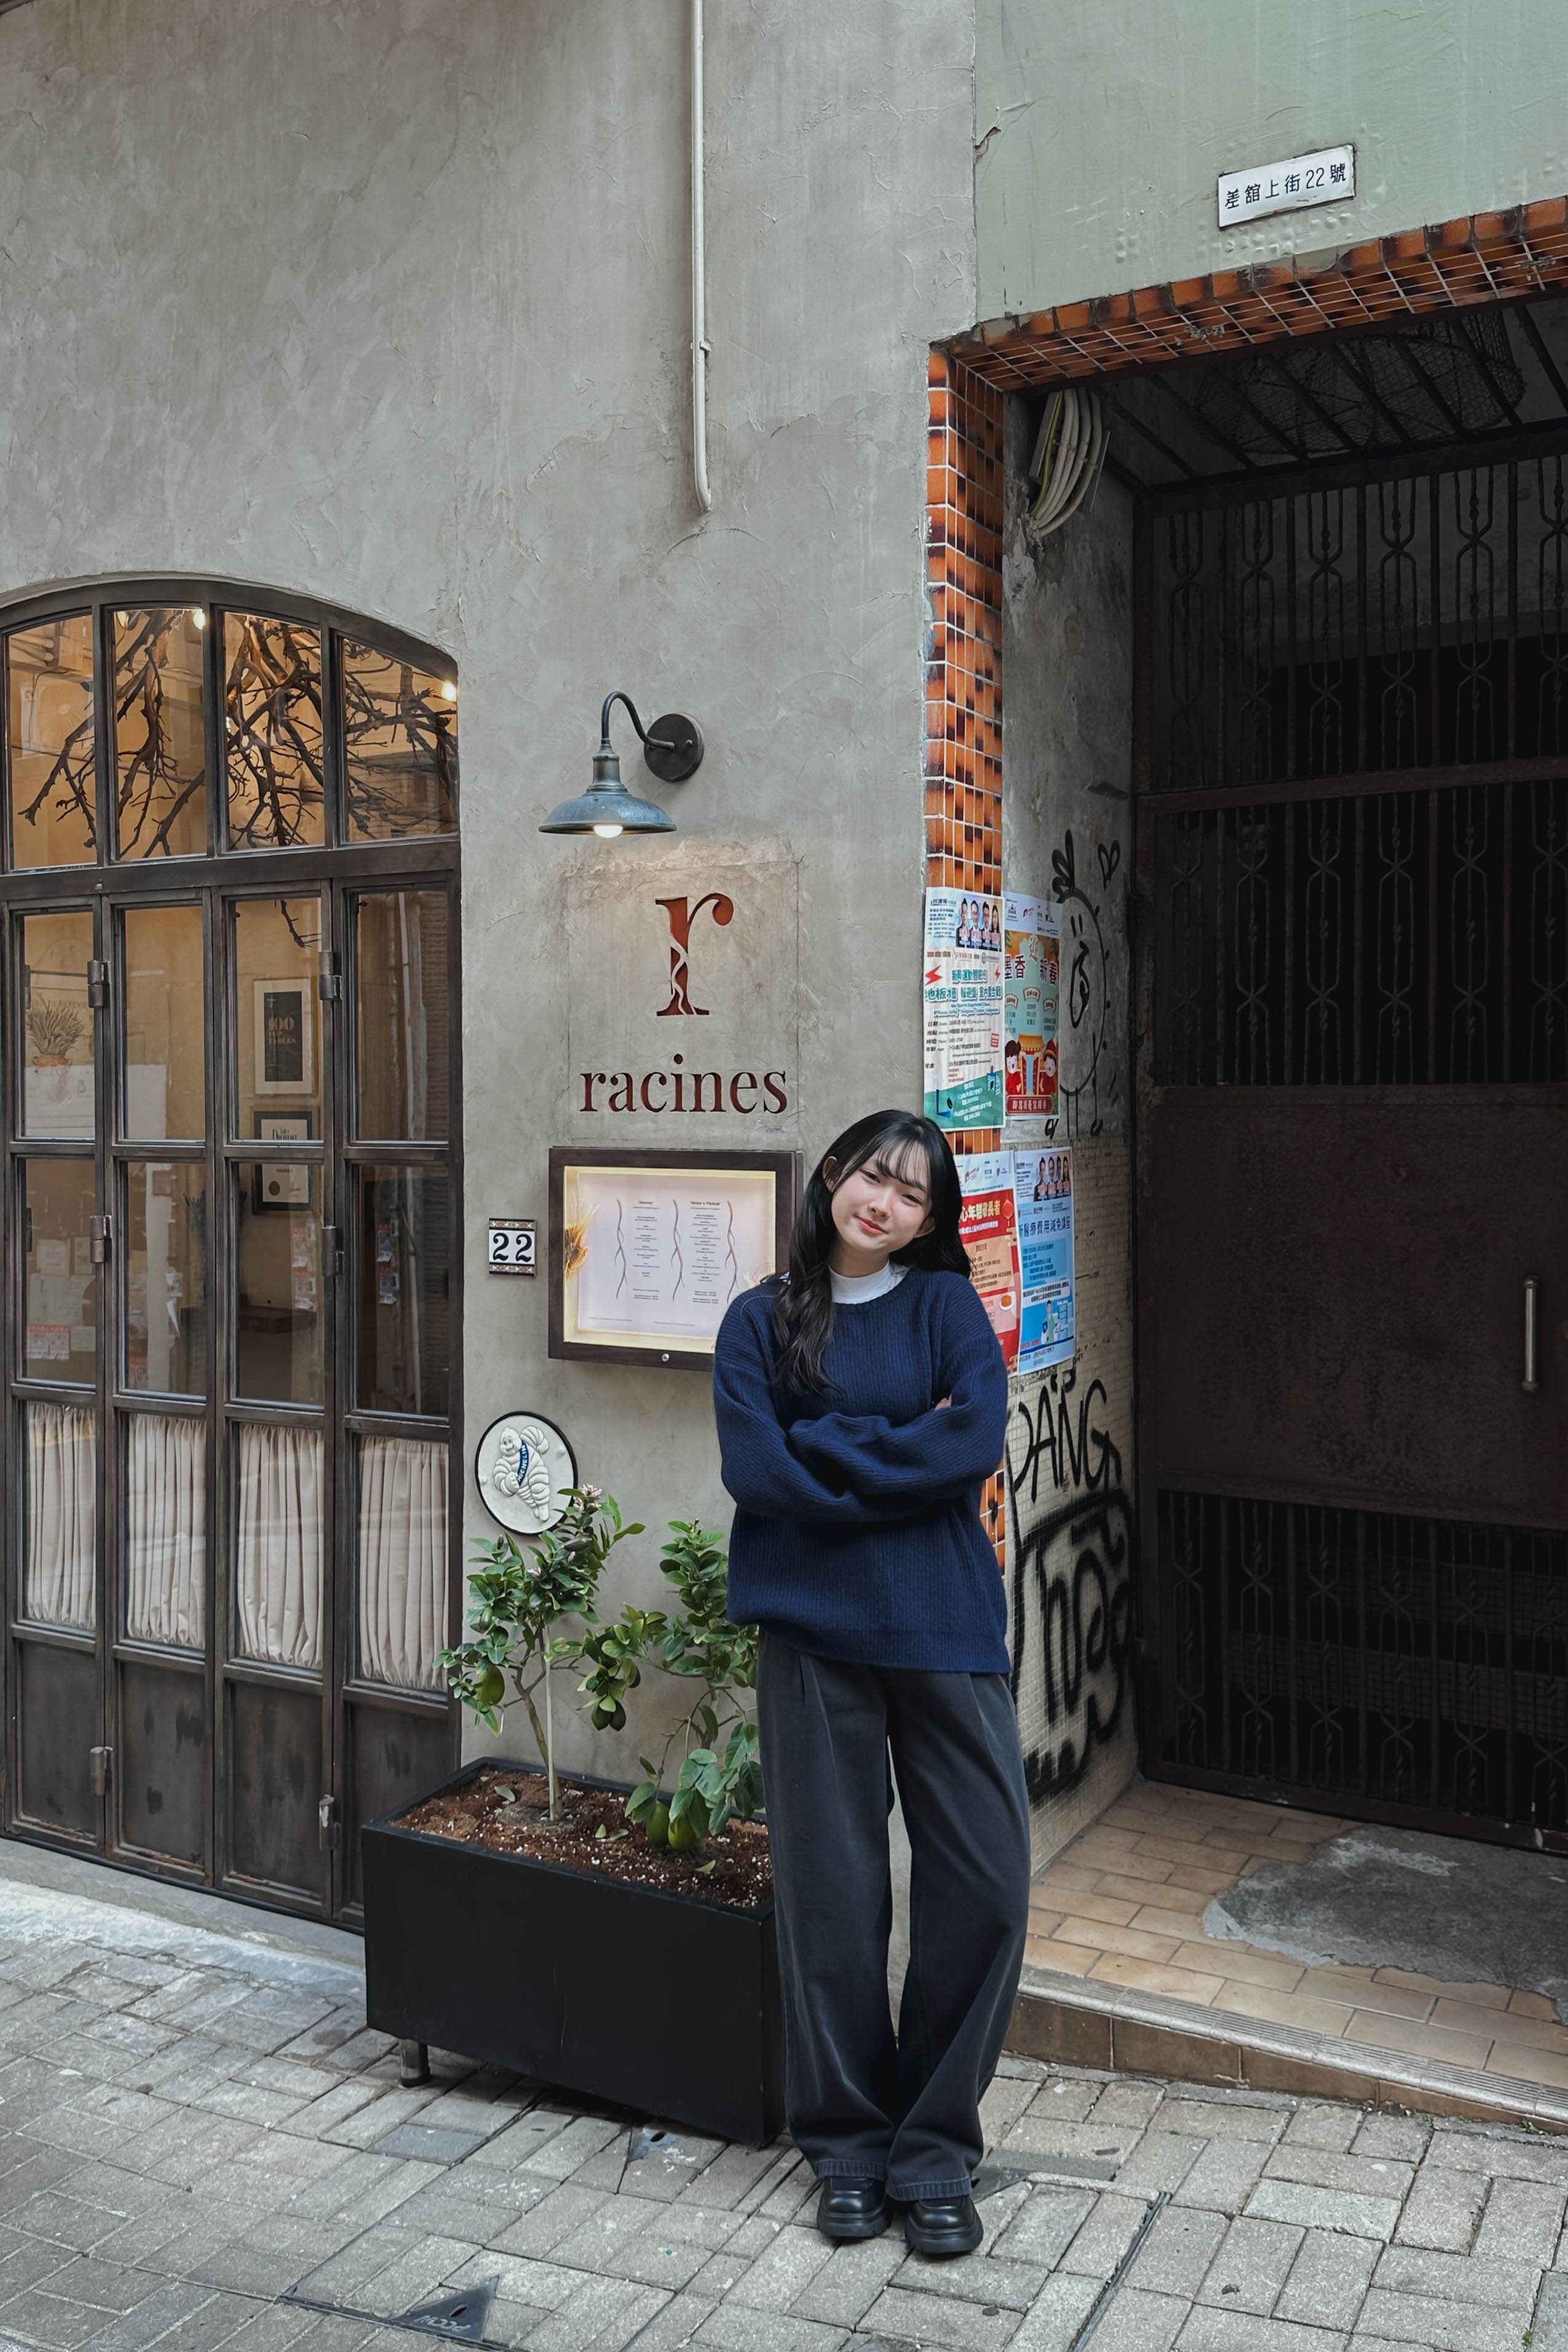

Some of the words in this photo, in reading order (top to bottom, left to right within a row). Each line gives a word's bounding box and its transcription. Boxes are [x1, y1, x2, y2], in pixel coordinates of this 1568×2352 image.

[655, 892, 734, 1016] r
[580, 1053, 788, 1114] racines
[493, 1232, 533, 1262] 22
[517, 1444, 528, 1482] MICHELIN
